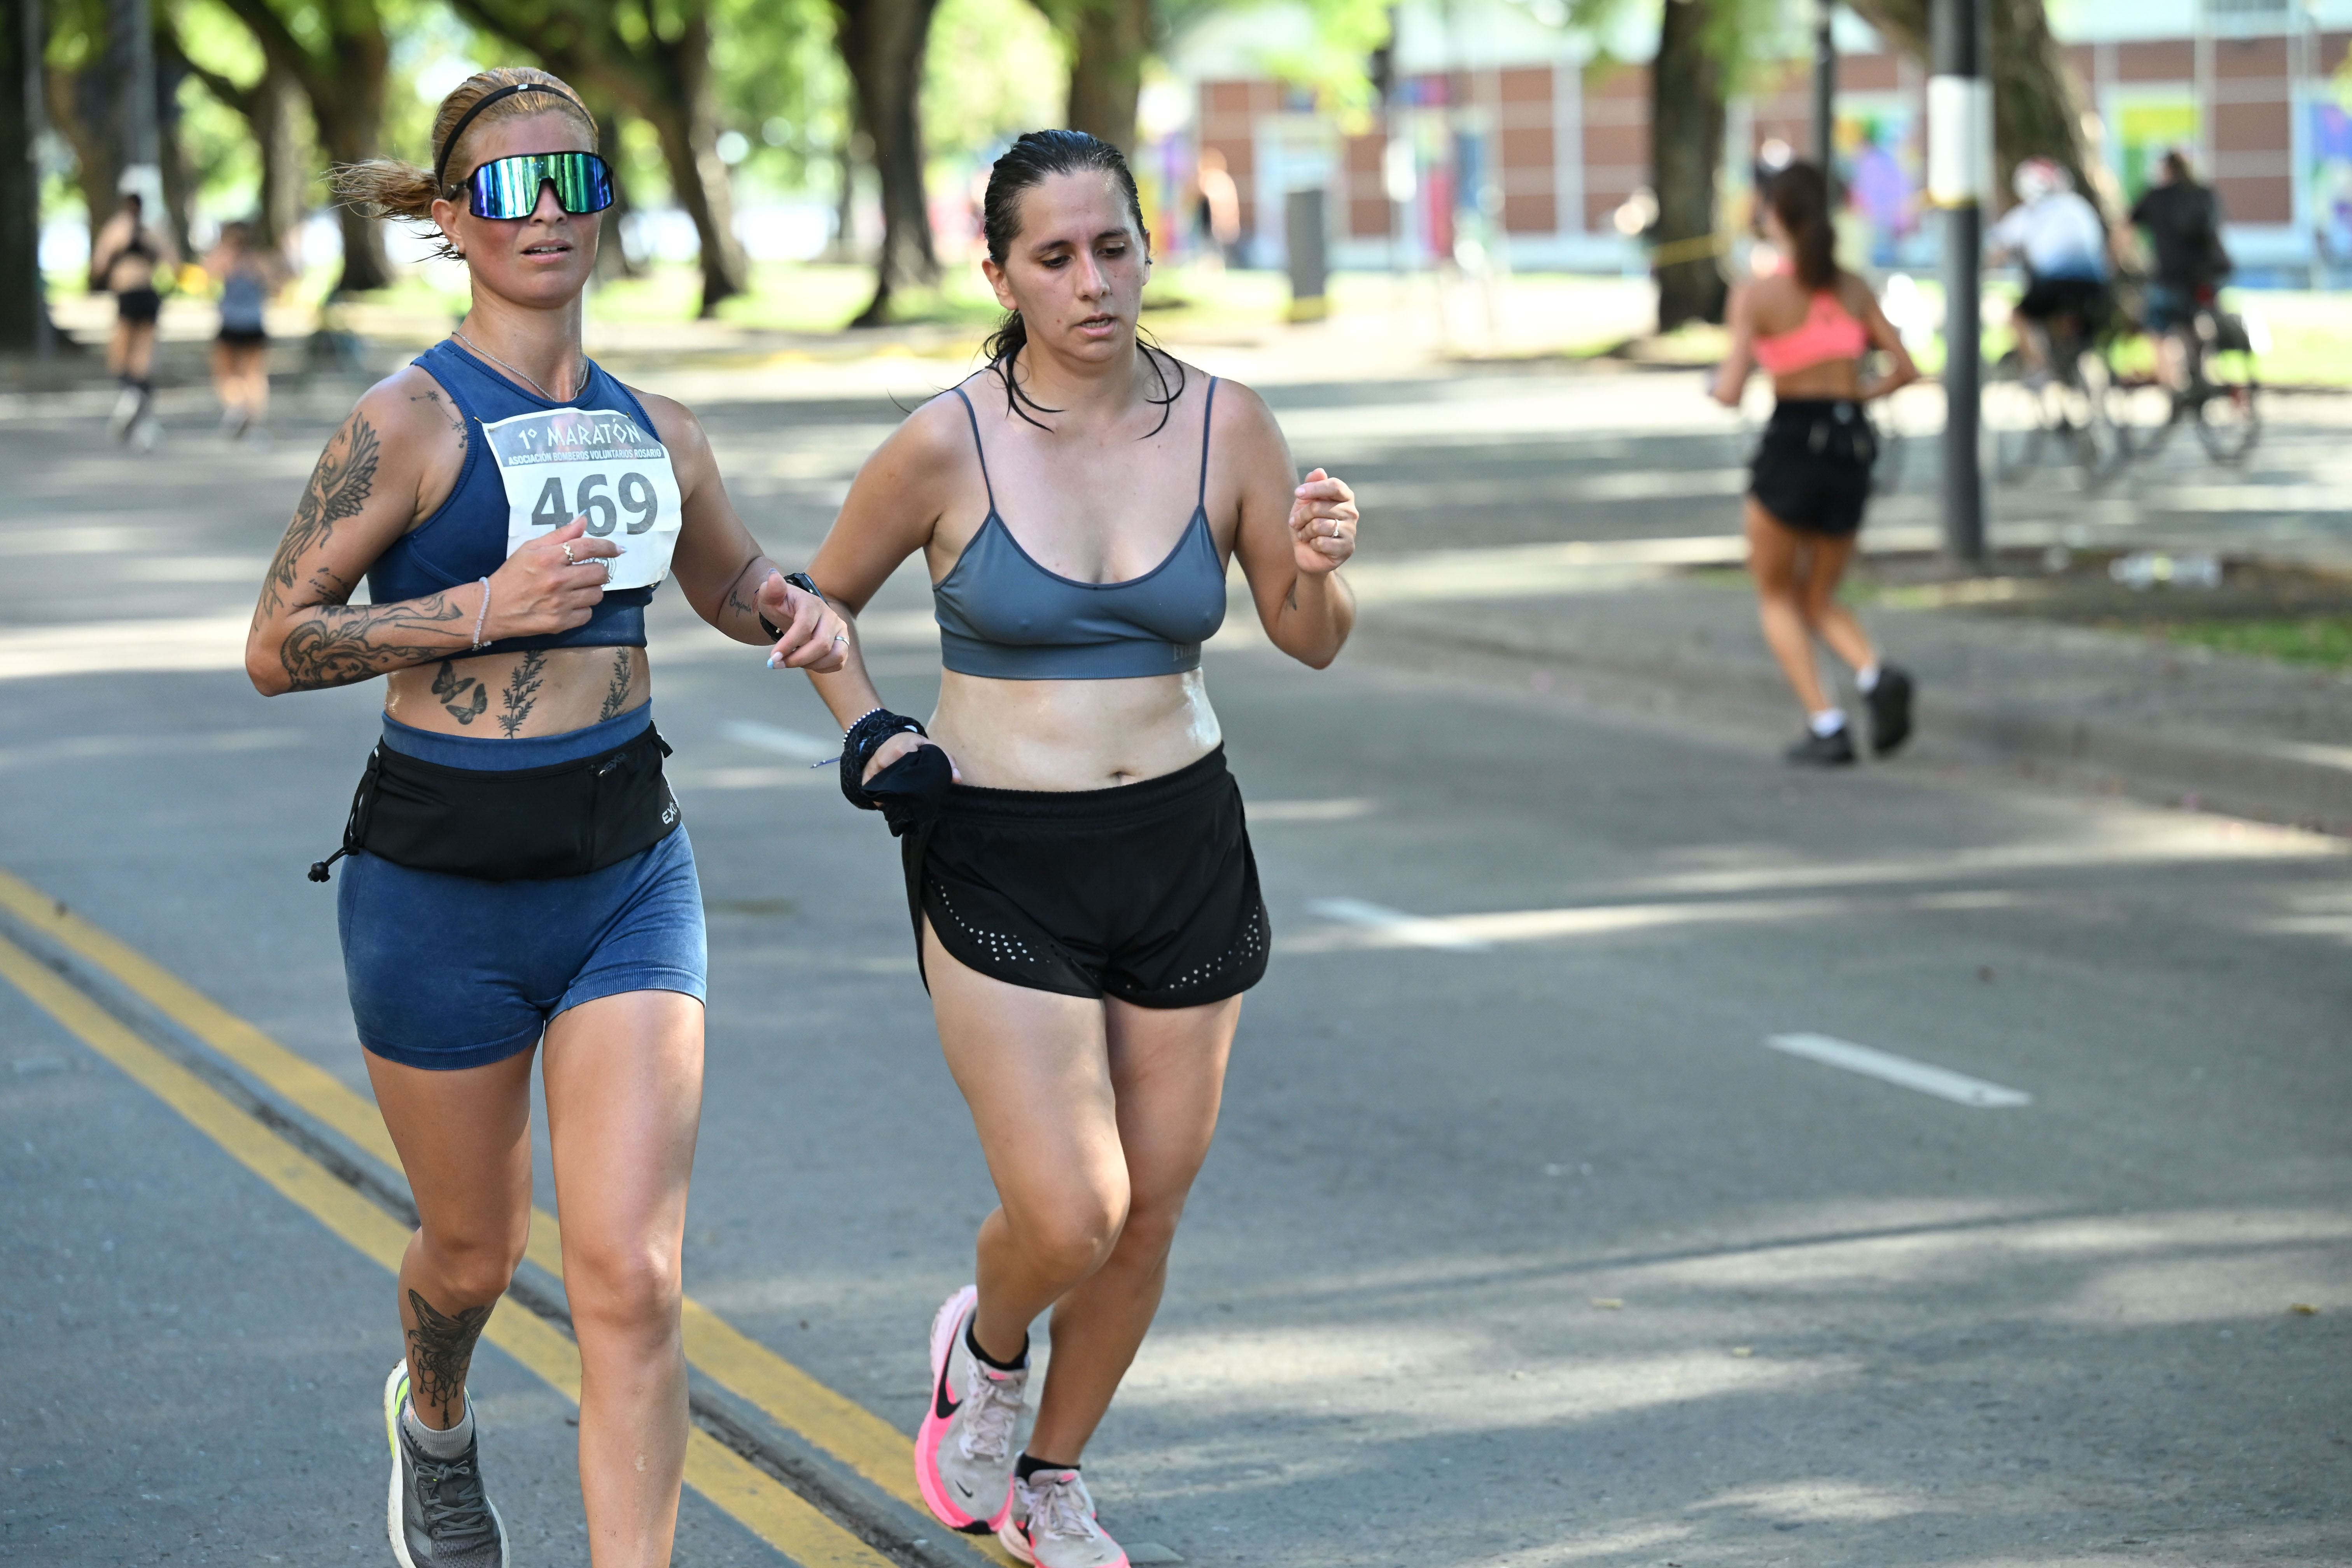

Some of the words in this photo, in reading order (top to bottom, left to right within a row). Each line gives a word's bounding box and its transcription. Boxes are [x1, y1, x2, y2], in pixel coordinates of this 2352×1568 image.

[547, 418, 641, 446] MARATÓN
[508, 451, 552, 466] ASOCIACIÓN
[553, 451, 590, 461] BOMBEROS
[590, 449, 634, 460] VOLUNTARIOS
[634, 448, 662, 458] ROSARIO
[532, 472, 658, 537] 469
